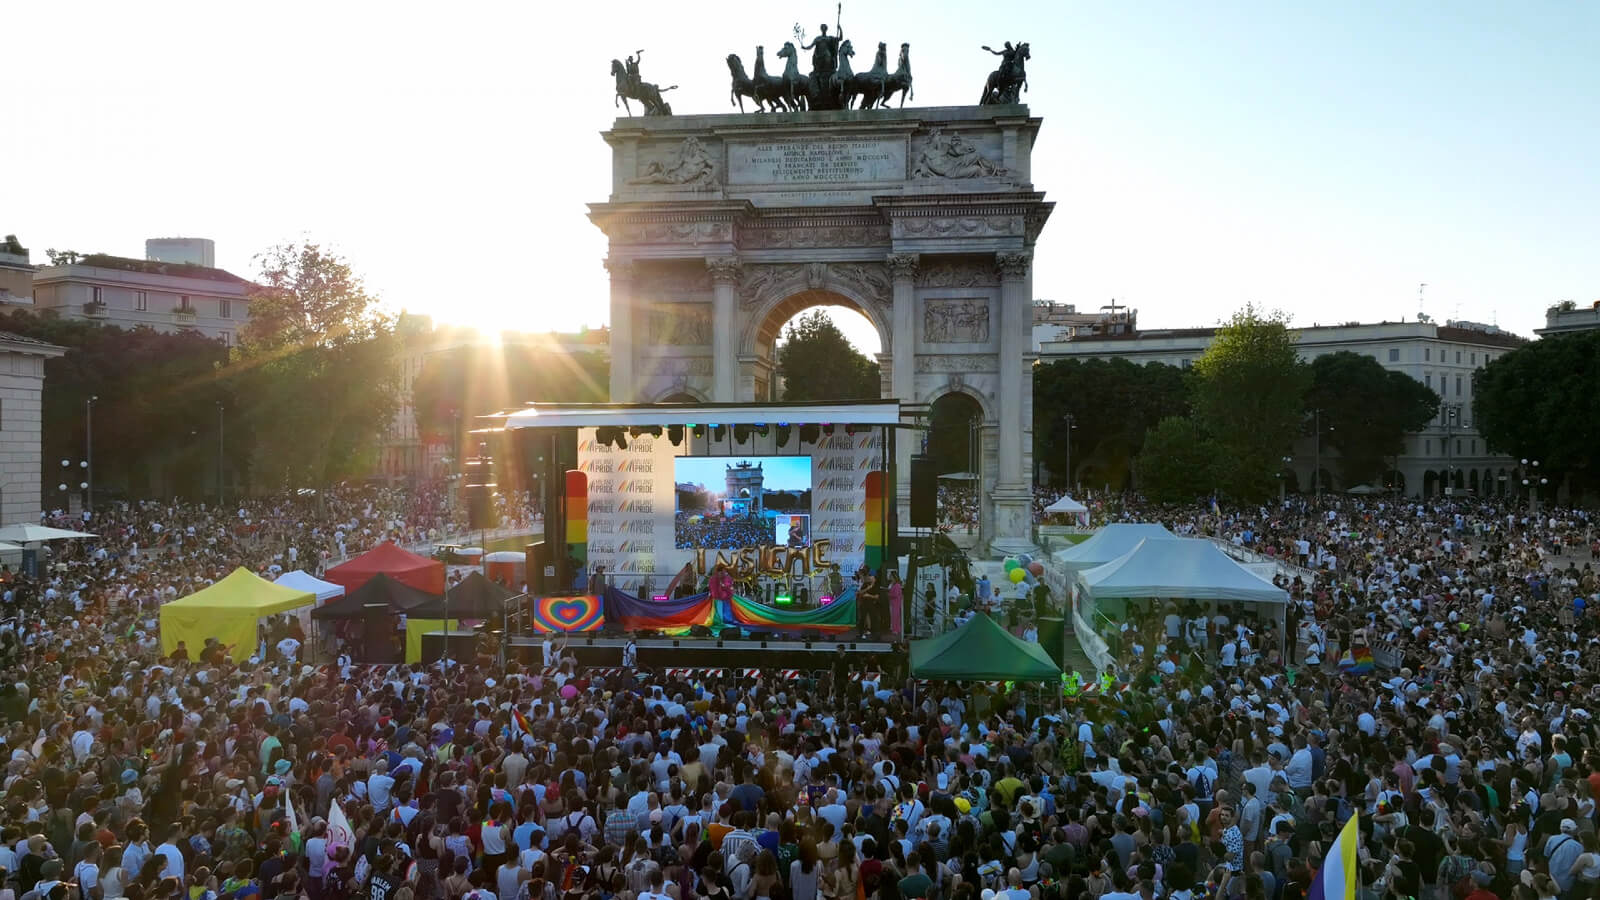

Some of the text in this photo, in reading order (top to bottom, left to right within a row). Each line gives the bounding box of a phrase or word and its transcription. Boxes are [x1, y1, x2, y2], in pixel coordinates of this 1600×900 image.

[635, 444, 653, 453] PRIDE
[596, 464, 613, 473] PRIDE
[635, 464, 653, 473] PRIDE
[836, 463, 854, 471] PRIDE
[596, 485, 613, 493] PRIDE
[636, 485, 653, 493] PRIDE
[836, 483, 853, 491] PRIDE
[635, 505, 653, 514] PRIDE
[836, 504, 853, 512] PRIDE
[636, 545, 655, 553] PRIDE
[836, 544, 853, 552] PRIDE
[697, 539, 831, 579] INSIEME
